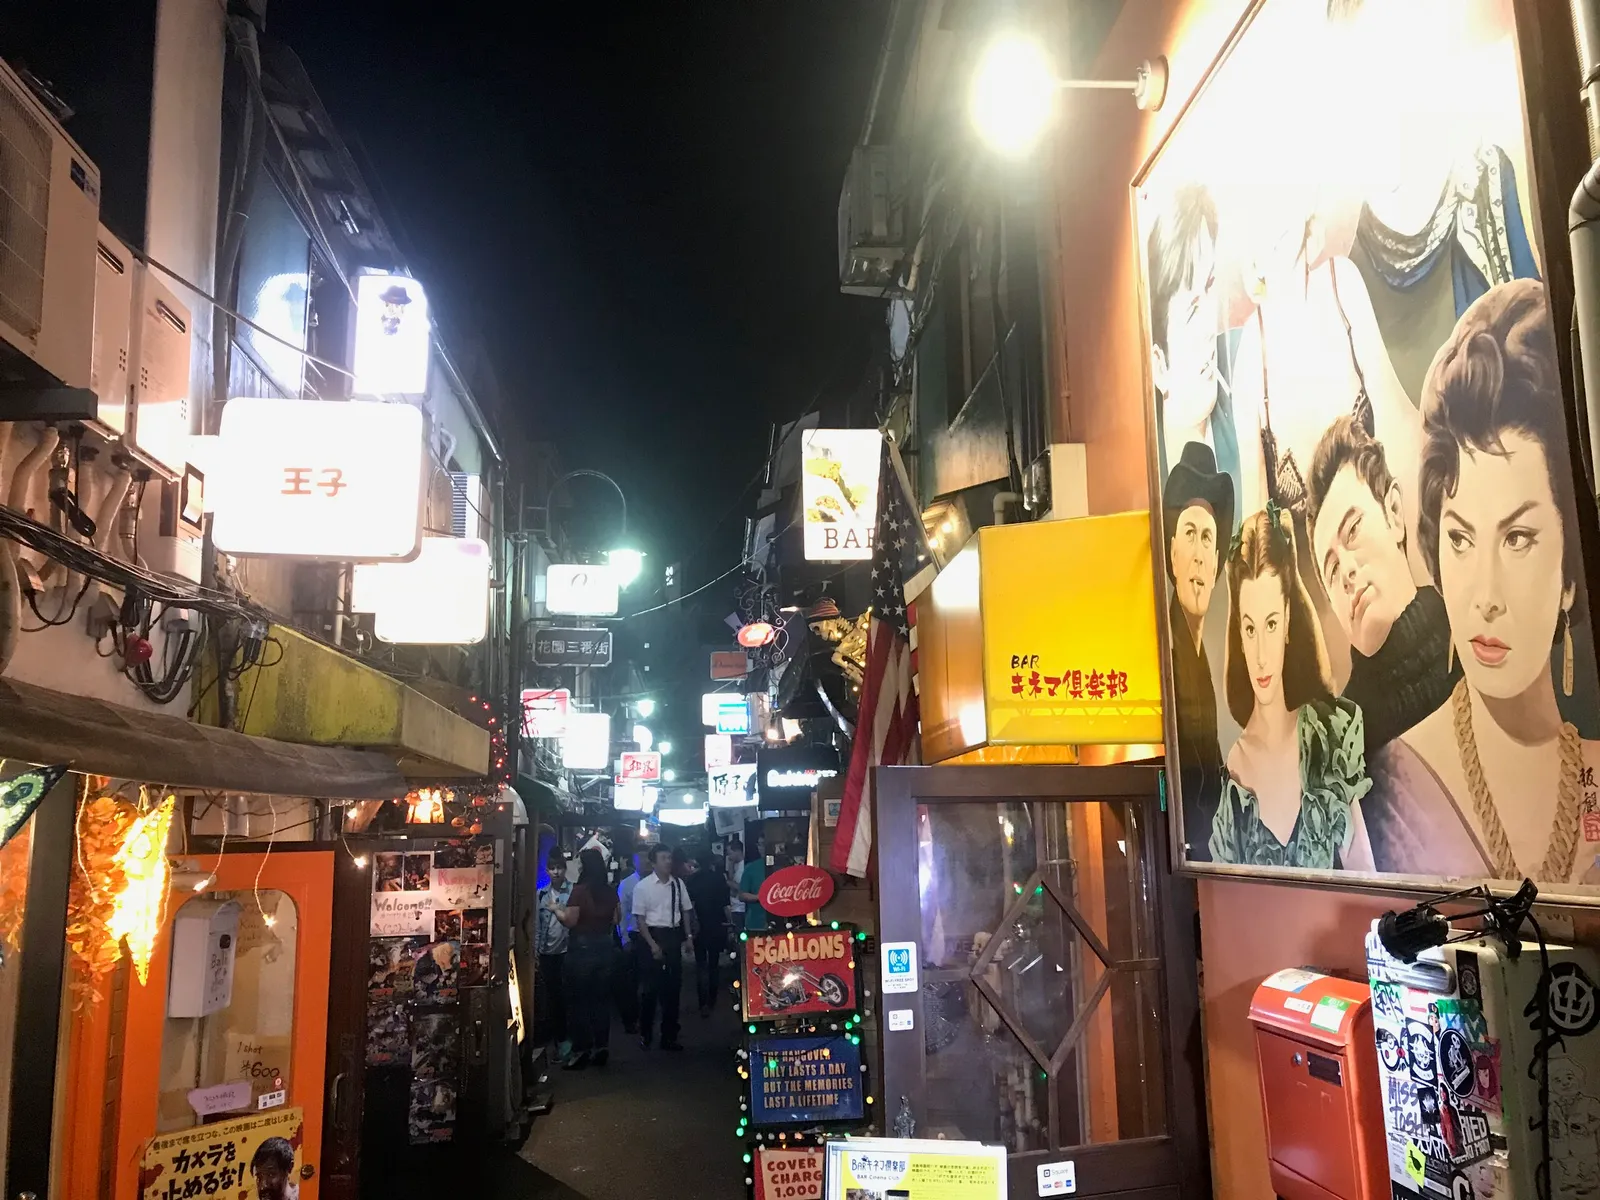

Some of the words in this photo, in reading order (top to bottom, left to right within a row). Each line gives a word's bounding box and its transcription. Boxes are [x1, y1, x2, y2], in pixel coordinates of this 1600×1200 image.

[280, 467, 348, 498] 王子
[1011, 655, 1040, 669] BAR
[1010, 669, 1128, 700] キネマ倶楽部
[766, 876, 824, 905] Coca-Cola
[763, 1066, 786, 1078] ONLY
[788, 1063, 817, 1077] LASTS
[819, 1063, 826, 1075] A
[828, 1062, 846, 1075] DAY
[763, 1080, 781, 1093] BUT
[785, 1080, 802, 1093] THE
[804, 1077, 853, 1092] MEMORIES
[764, 1095, 786, 1109] LAST
[789, 1096, 796, 1108] A
[798, 1093, 839, 1107] LIFETIME
[172, 1141, 237, 1174] カメラを
[767, 1157, 817, 1172] COVER
